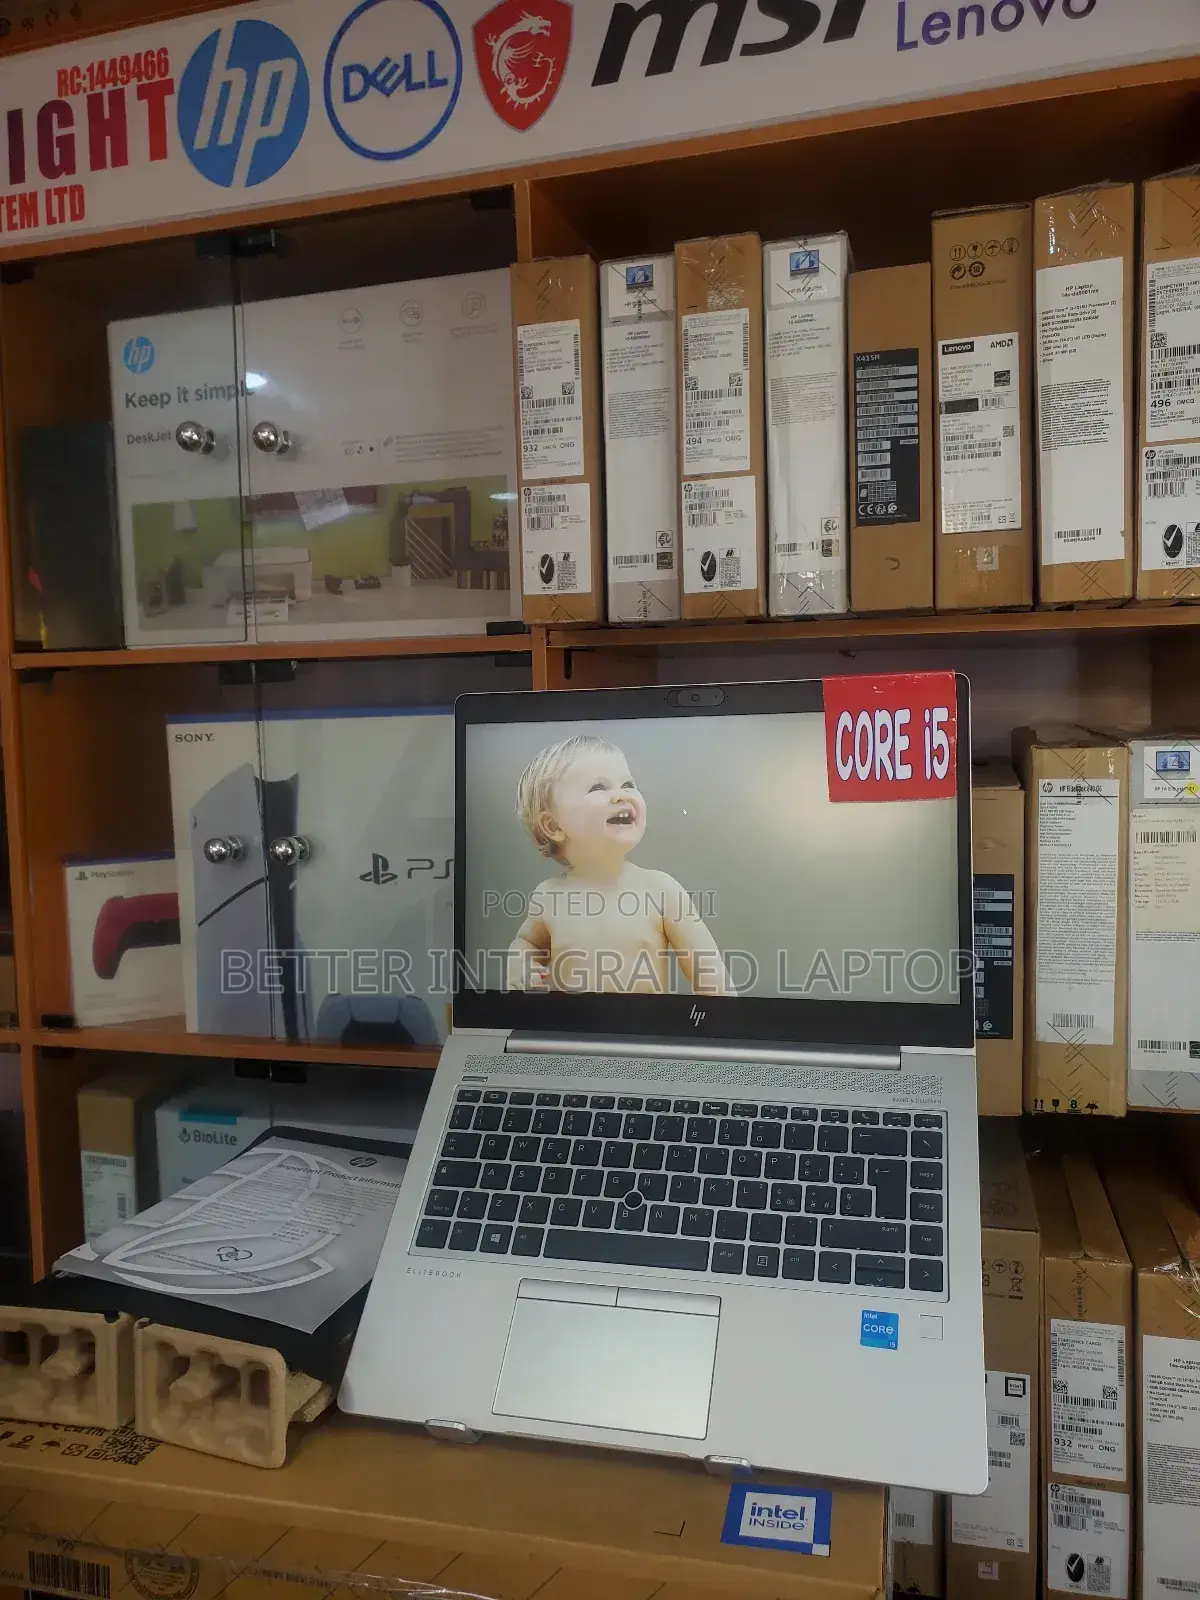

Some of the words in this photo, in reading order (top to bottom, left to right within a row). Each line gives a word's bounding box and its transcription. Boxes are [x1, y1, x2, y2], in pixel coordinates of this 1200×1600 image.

[896, 0, 1096, 52] Lenovo
[56, 48, 169, 98] RC:1449466
[342, 49, 449, 105] DELL
[7, 79, 175, 185] IGHT
[45, 184, 85, 226] LTD
[945, 344, 971, 353] Lenovo
[990, 340, 1006, 348] AMD
[856, 354, 880, 362] X415M
[125, 392, 171, 409] Keep
[177, 386, 189, 403] it
[1151, 399, 1171, 409] 496
[127, 430, 171, 444] DeskJet
[686, 437, 702, 446] 494
[523, 444, 538, 453] 932
[175, 733, 214, 743] SONY
[834, 707, 914, 783] CORE
[923, 706, 951, 780] i5
[193, 1129, 237, 1146] BioLite
[277, 1163, 322, 1175] Important
[322, 1170, 359, 1182] Product
[526, 1201, 534, 1209] X
[406, 1267, 462, 1278] ELITEBOOK
[863, 1312, 878, 1320] intel
[1054, 1438, 1072, 1448] 932
[750, 1502, 806, 1521] intel
